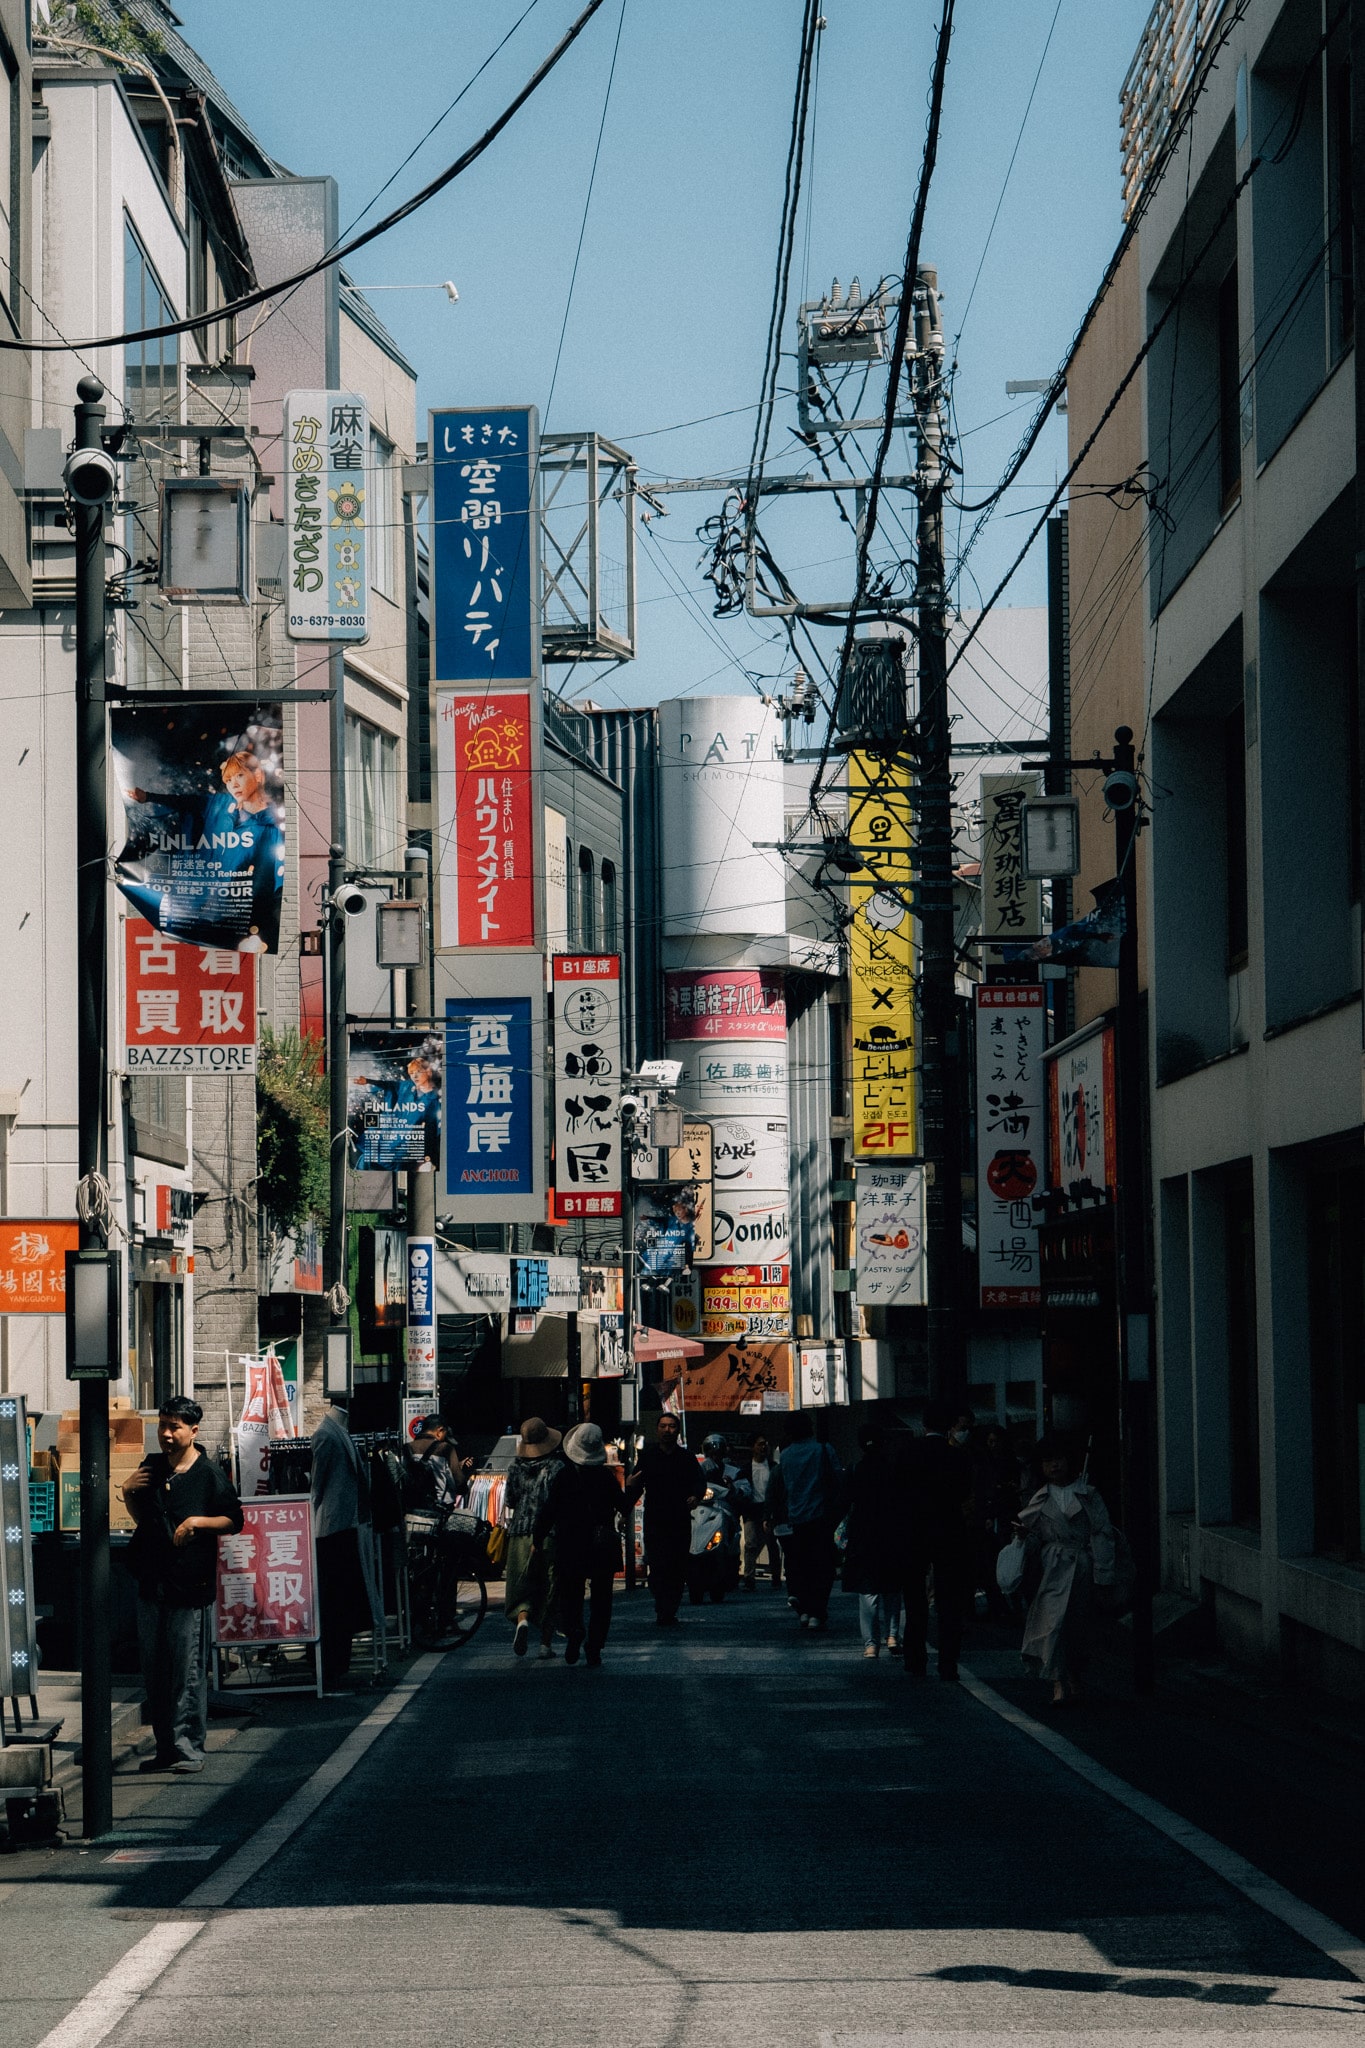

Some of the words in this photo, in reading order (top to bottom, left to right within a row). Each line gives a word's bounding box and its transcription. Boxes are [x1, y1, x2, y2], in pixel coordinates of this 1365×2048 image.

[329, 404, 363, 471] 麻雀
[444, 424, 518, 453] しもきた
[292, 416, 324, 592] かめきたざわ
[460, 459, 504, 661] 空間リバティ
[290, 615, 366, 627] 03-6379-8030
[441, 702, 477, 722] House
[468, 705, 502, 730] Mate
[149, 831, 255, 851] FINLANDS
[475, 778, 500, 940] ハウスメイト
[207, 887, 254, 897] TOUR
[562, 960, 580, 974] B1
[582, 960, 611, 975] 座席
[135, 989, 246, 1035] 買取
[704, 1019, 723, 1034] 4F
[127, 1047, 253, 1065] BAZZSTORE
[1014, 1015, 1032, 1082] やきとん
[705, 1062, 785, 1080] 佐藤歯科
[465, 1014, 514, 1153] 西海岸
[364, 1102, 426, 1113] FINLANDS
[861, 1122, 909, 1148] 2F
[460, 1168, 520, 1182] ANCHOR
[871, 1173, 908, 1188] 珈琲
[564, 1199, 582, 1213] B1
[585, 1197, 615, 1213] 座席
[862, 1192, 917, 1207] 洋菓子
[760, 1265, 783, 1284] 1階
[868, 1281, 912, 1294] ザック
[9, 1295, 57, 1303] YANGGUOFU
[244, 1508, 304, 1525] り下さい
[218, 1530, 304, 1570] 春夏
[220, 1572, 306, 1610] 買取
[219, 1611, 309, 1634] スタート!
